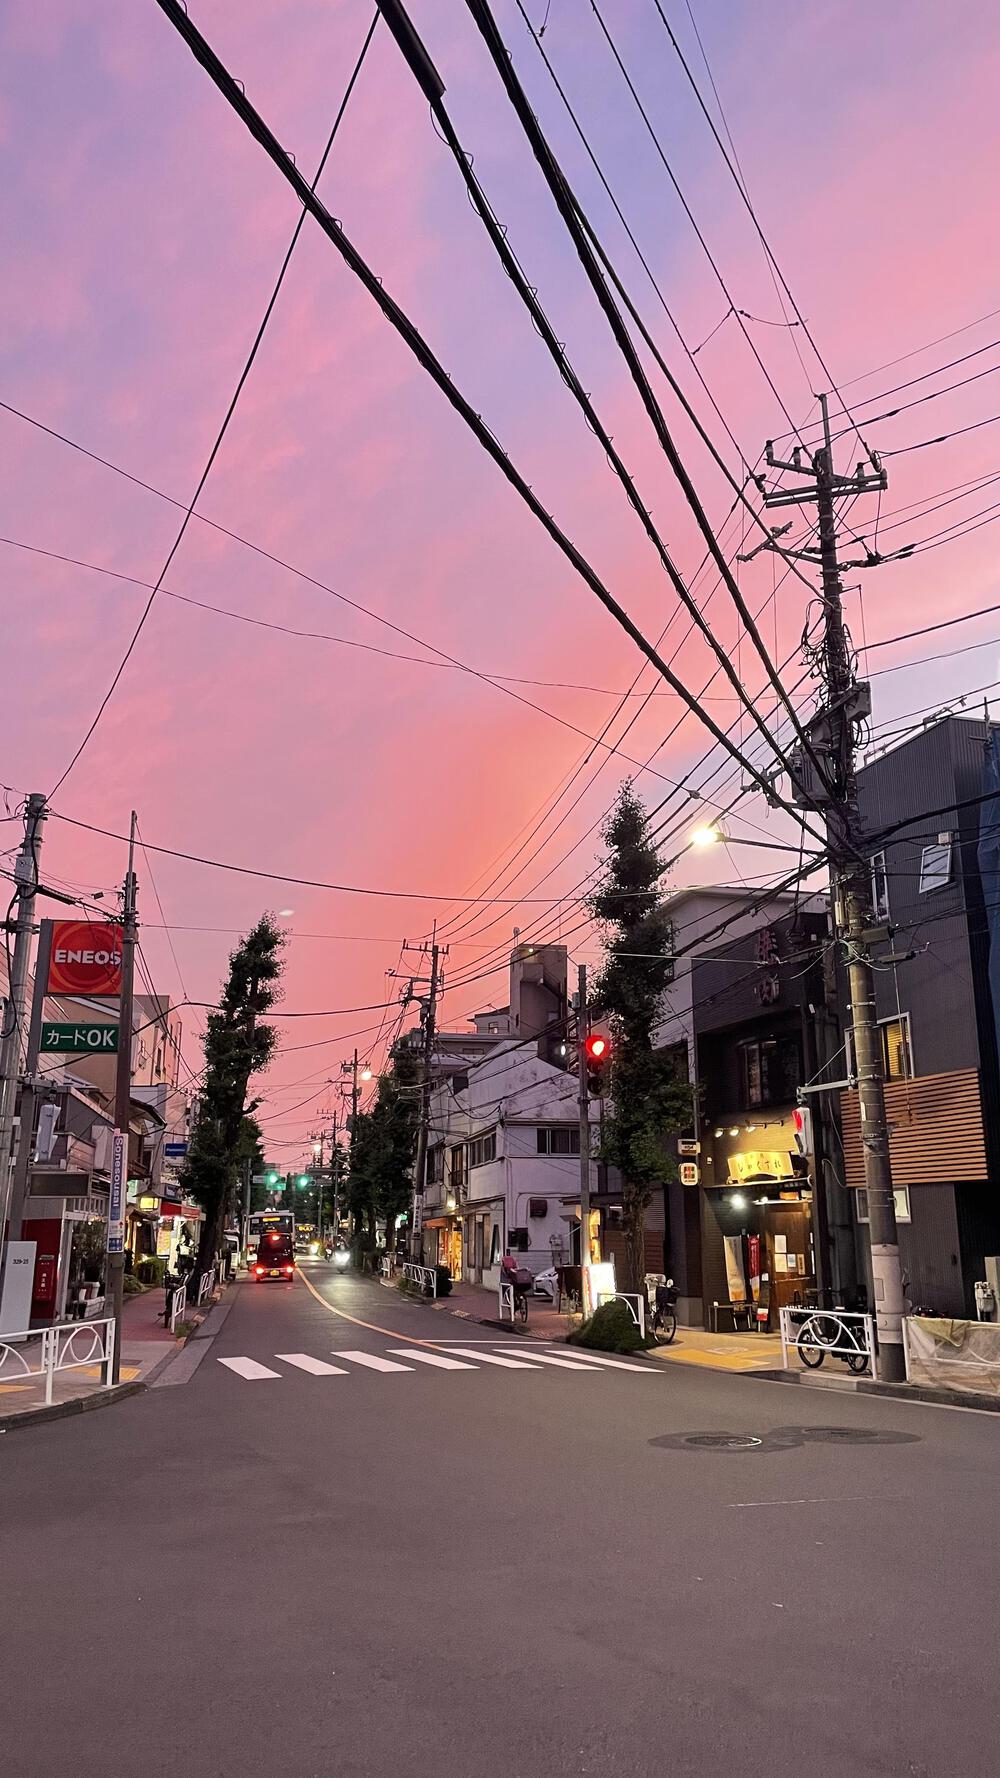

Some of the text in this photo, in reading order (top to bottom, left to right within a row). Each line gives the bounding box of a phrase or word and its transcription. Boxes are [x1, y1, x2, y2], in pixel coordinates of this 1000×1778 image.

[54, 949, 121, 965] ENEOS
[46, 1029, 115, 1047] カードOK
